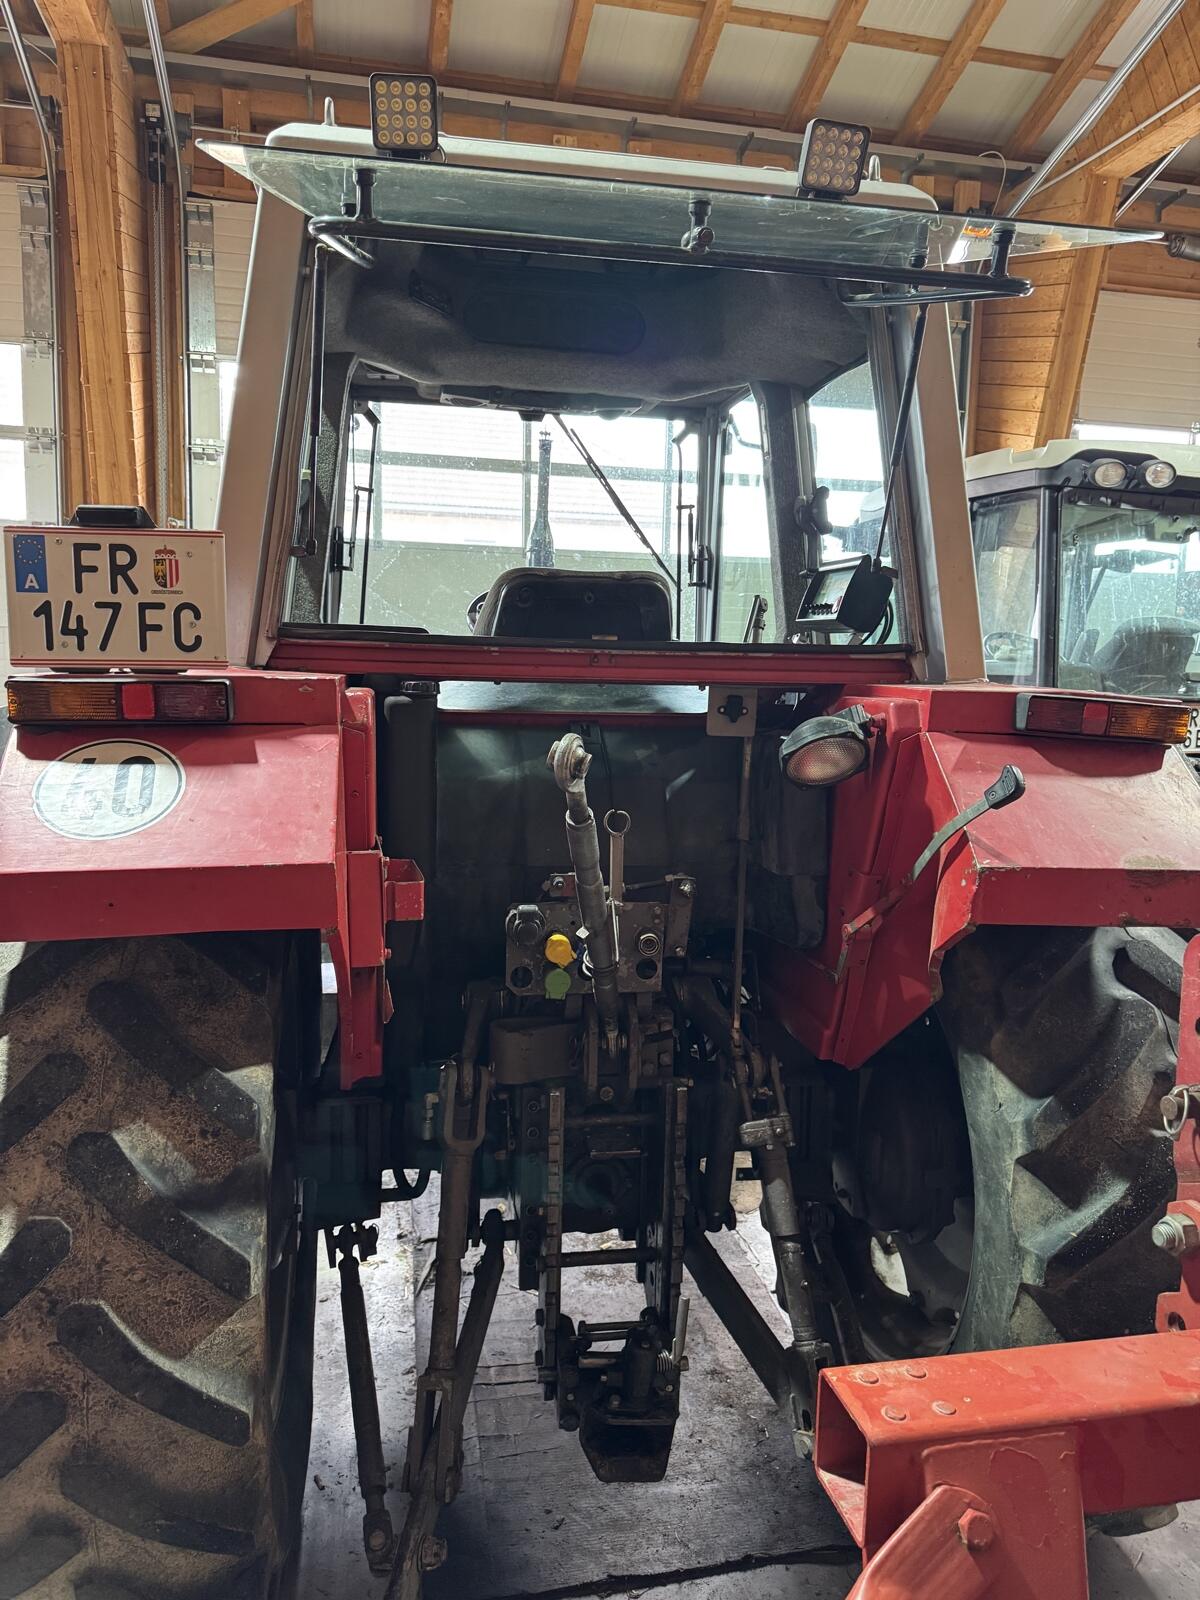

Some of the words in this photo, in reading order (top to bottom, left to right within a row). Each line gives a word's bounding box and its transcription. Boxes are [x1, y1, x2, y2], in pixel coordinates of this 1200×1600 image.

[24, 574, 40, 589] A
[73, 543, 139, 594] FR
[33, 600, 122, 651] 147
